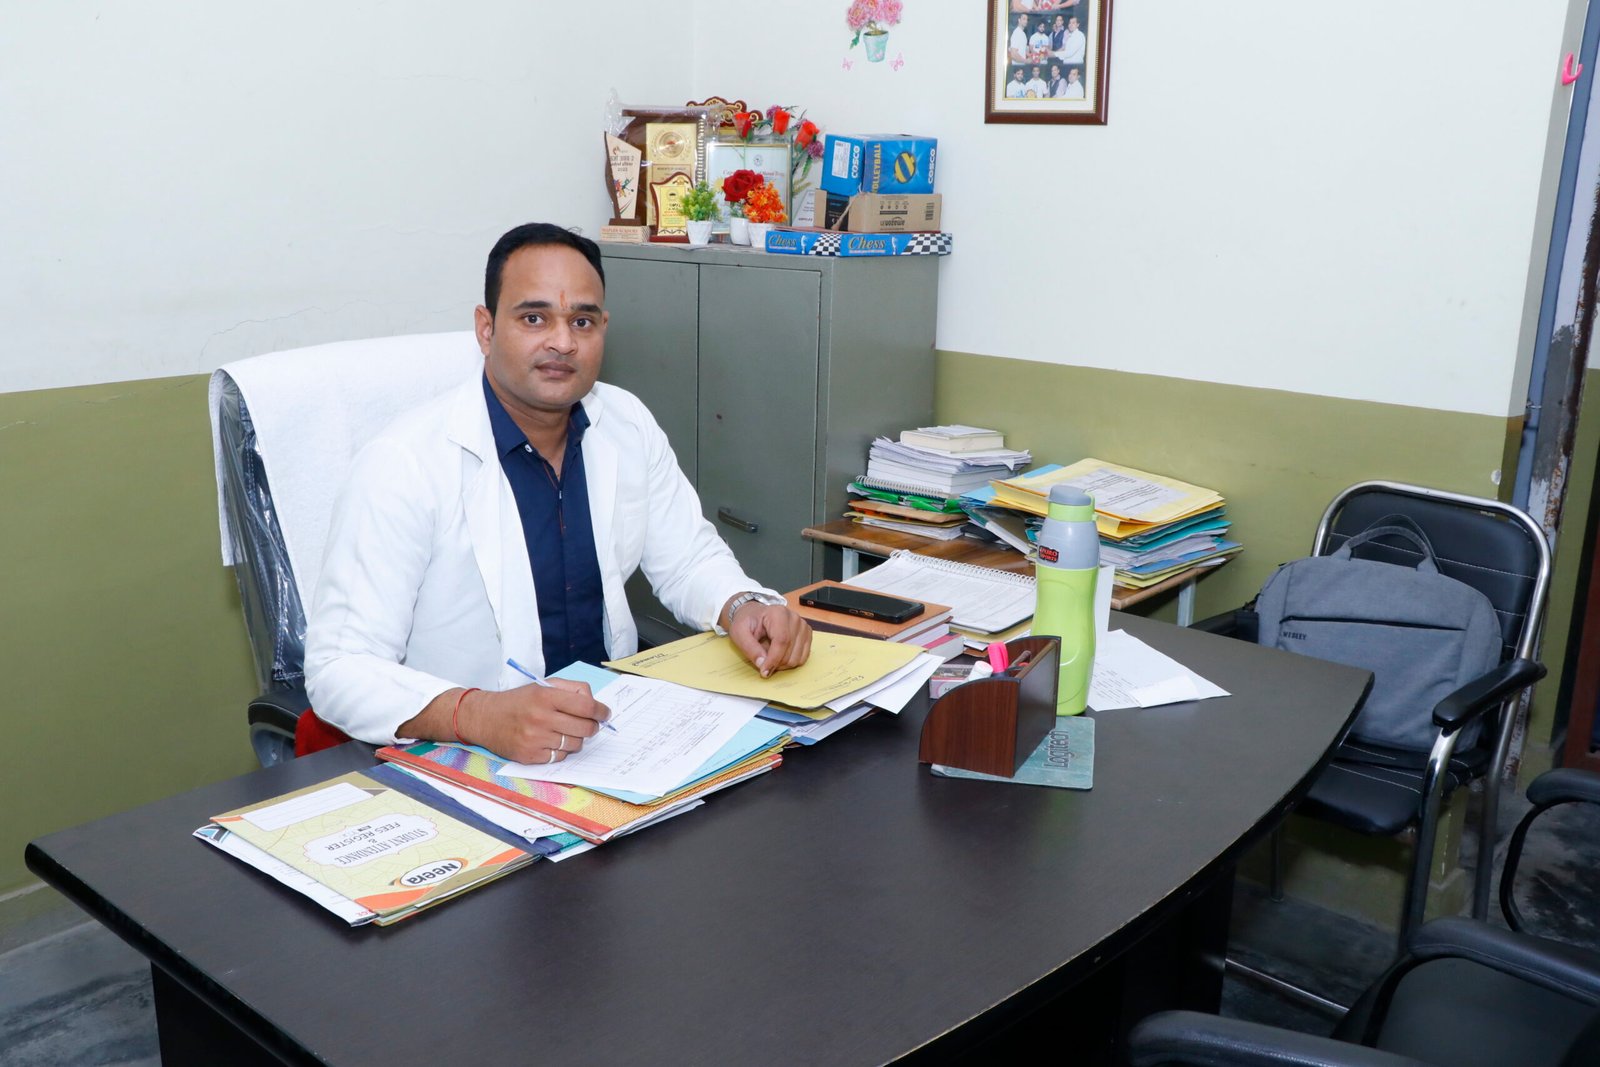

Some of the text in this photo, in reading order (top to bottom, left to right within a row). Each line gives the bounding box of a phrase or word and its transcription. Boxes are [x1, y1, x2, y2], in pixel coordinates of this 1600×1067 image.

[851, 145, 860, 179] COSCO
[871, 143, 882, 193] VOLLEYBALL
[928, 148, 936, 184] COSCO
[768, 234, 797, 247] Chess
[849, 234, 886, 249] Chess
[1042, 729, 1075, 768] Logitech
[325, 831, 375, 851] REGISTER
[374, 821, 401, 834] FEES
[334, 828, 429, 865] STUDENT ATTENDANCE
[407, 863, 459, 884] Neera
